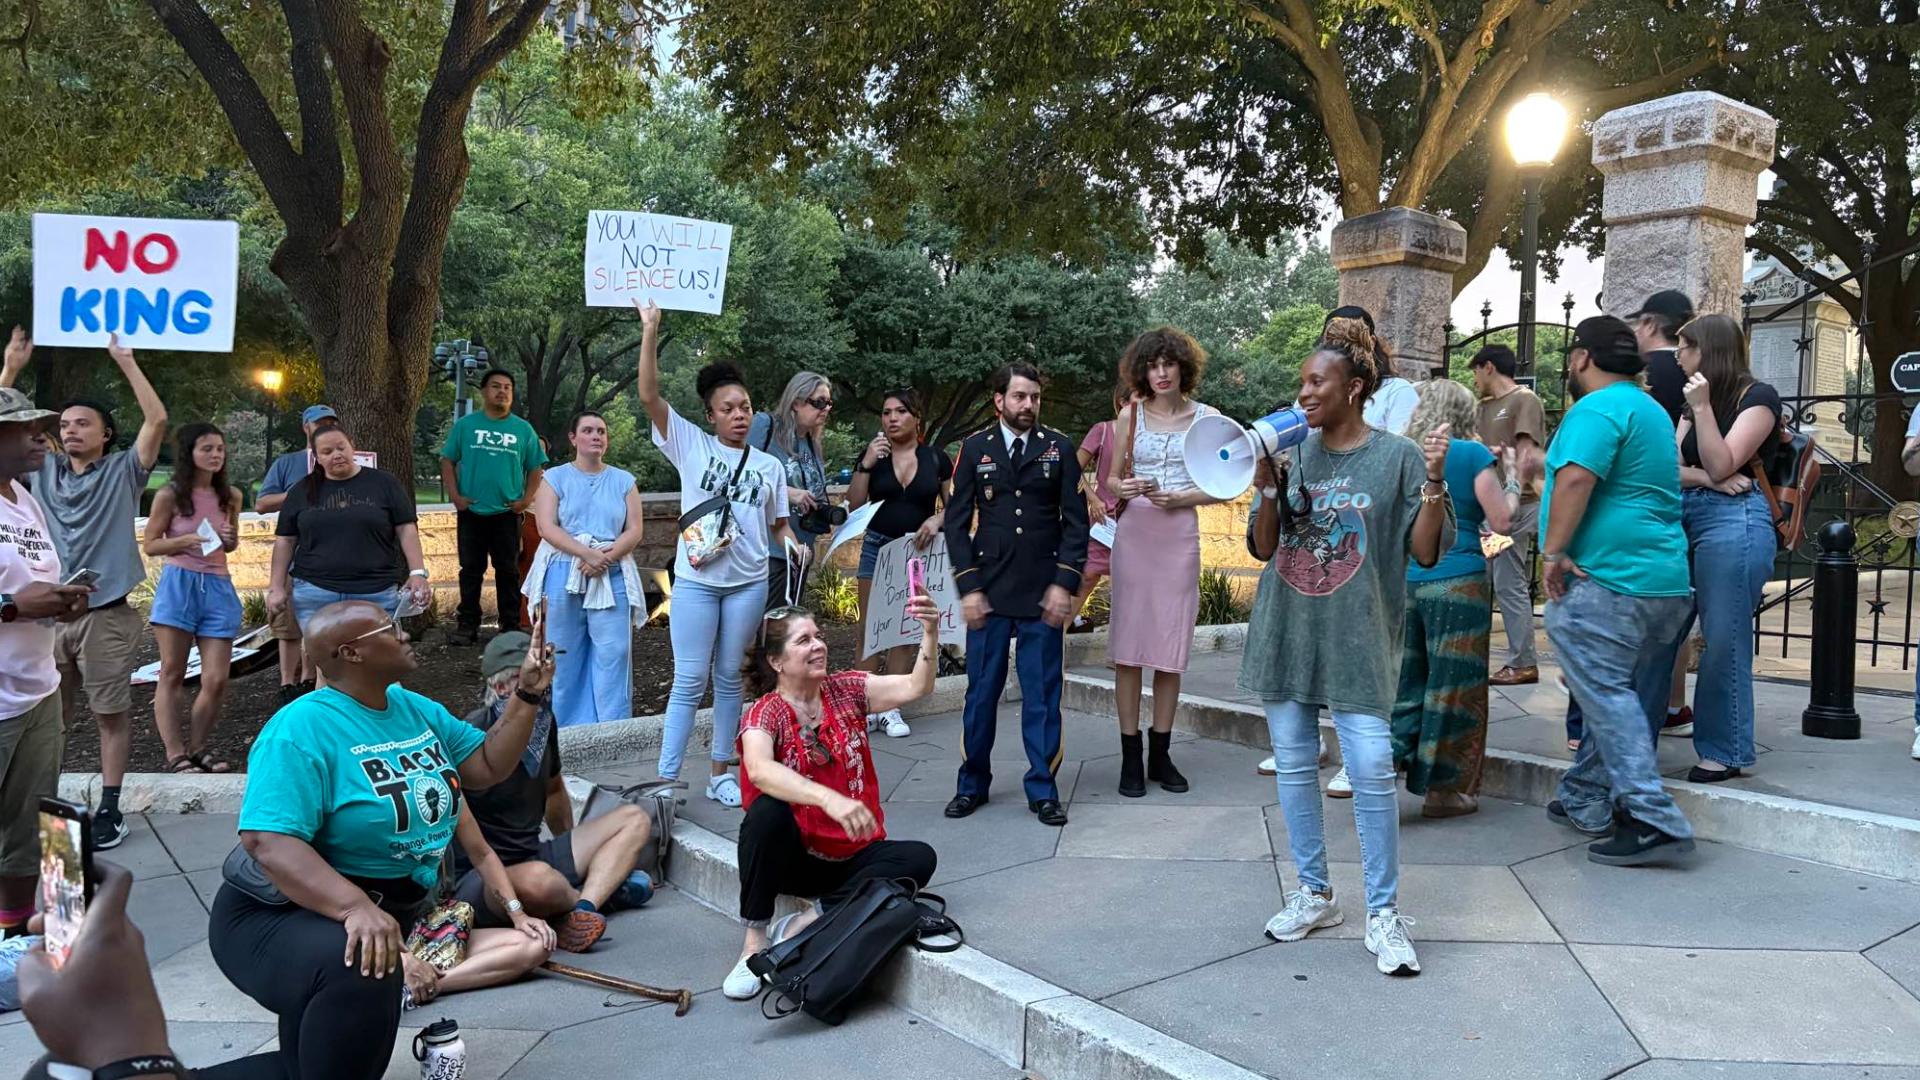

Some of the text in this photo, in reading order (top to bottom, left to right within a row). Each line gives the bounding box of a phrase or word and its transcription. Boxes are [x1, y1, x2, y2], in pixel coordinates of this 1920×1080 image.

[83, 227, 179, 275] NO
[594, 212, 723, 250] YOU WILL
[621, 243, 676, 270] NOT
[594, 266, 719, 299] SILENCE US!
[60, 286, 213, 336] KING
[474, 429, 517, 447] TOP
[875, 547, 894, 587] My
[871, 603, 957, 650] your Esrt
[361, 741, 448, 784] BLACK
